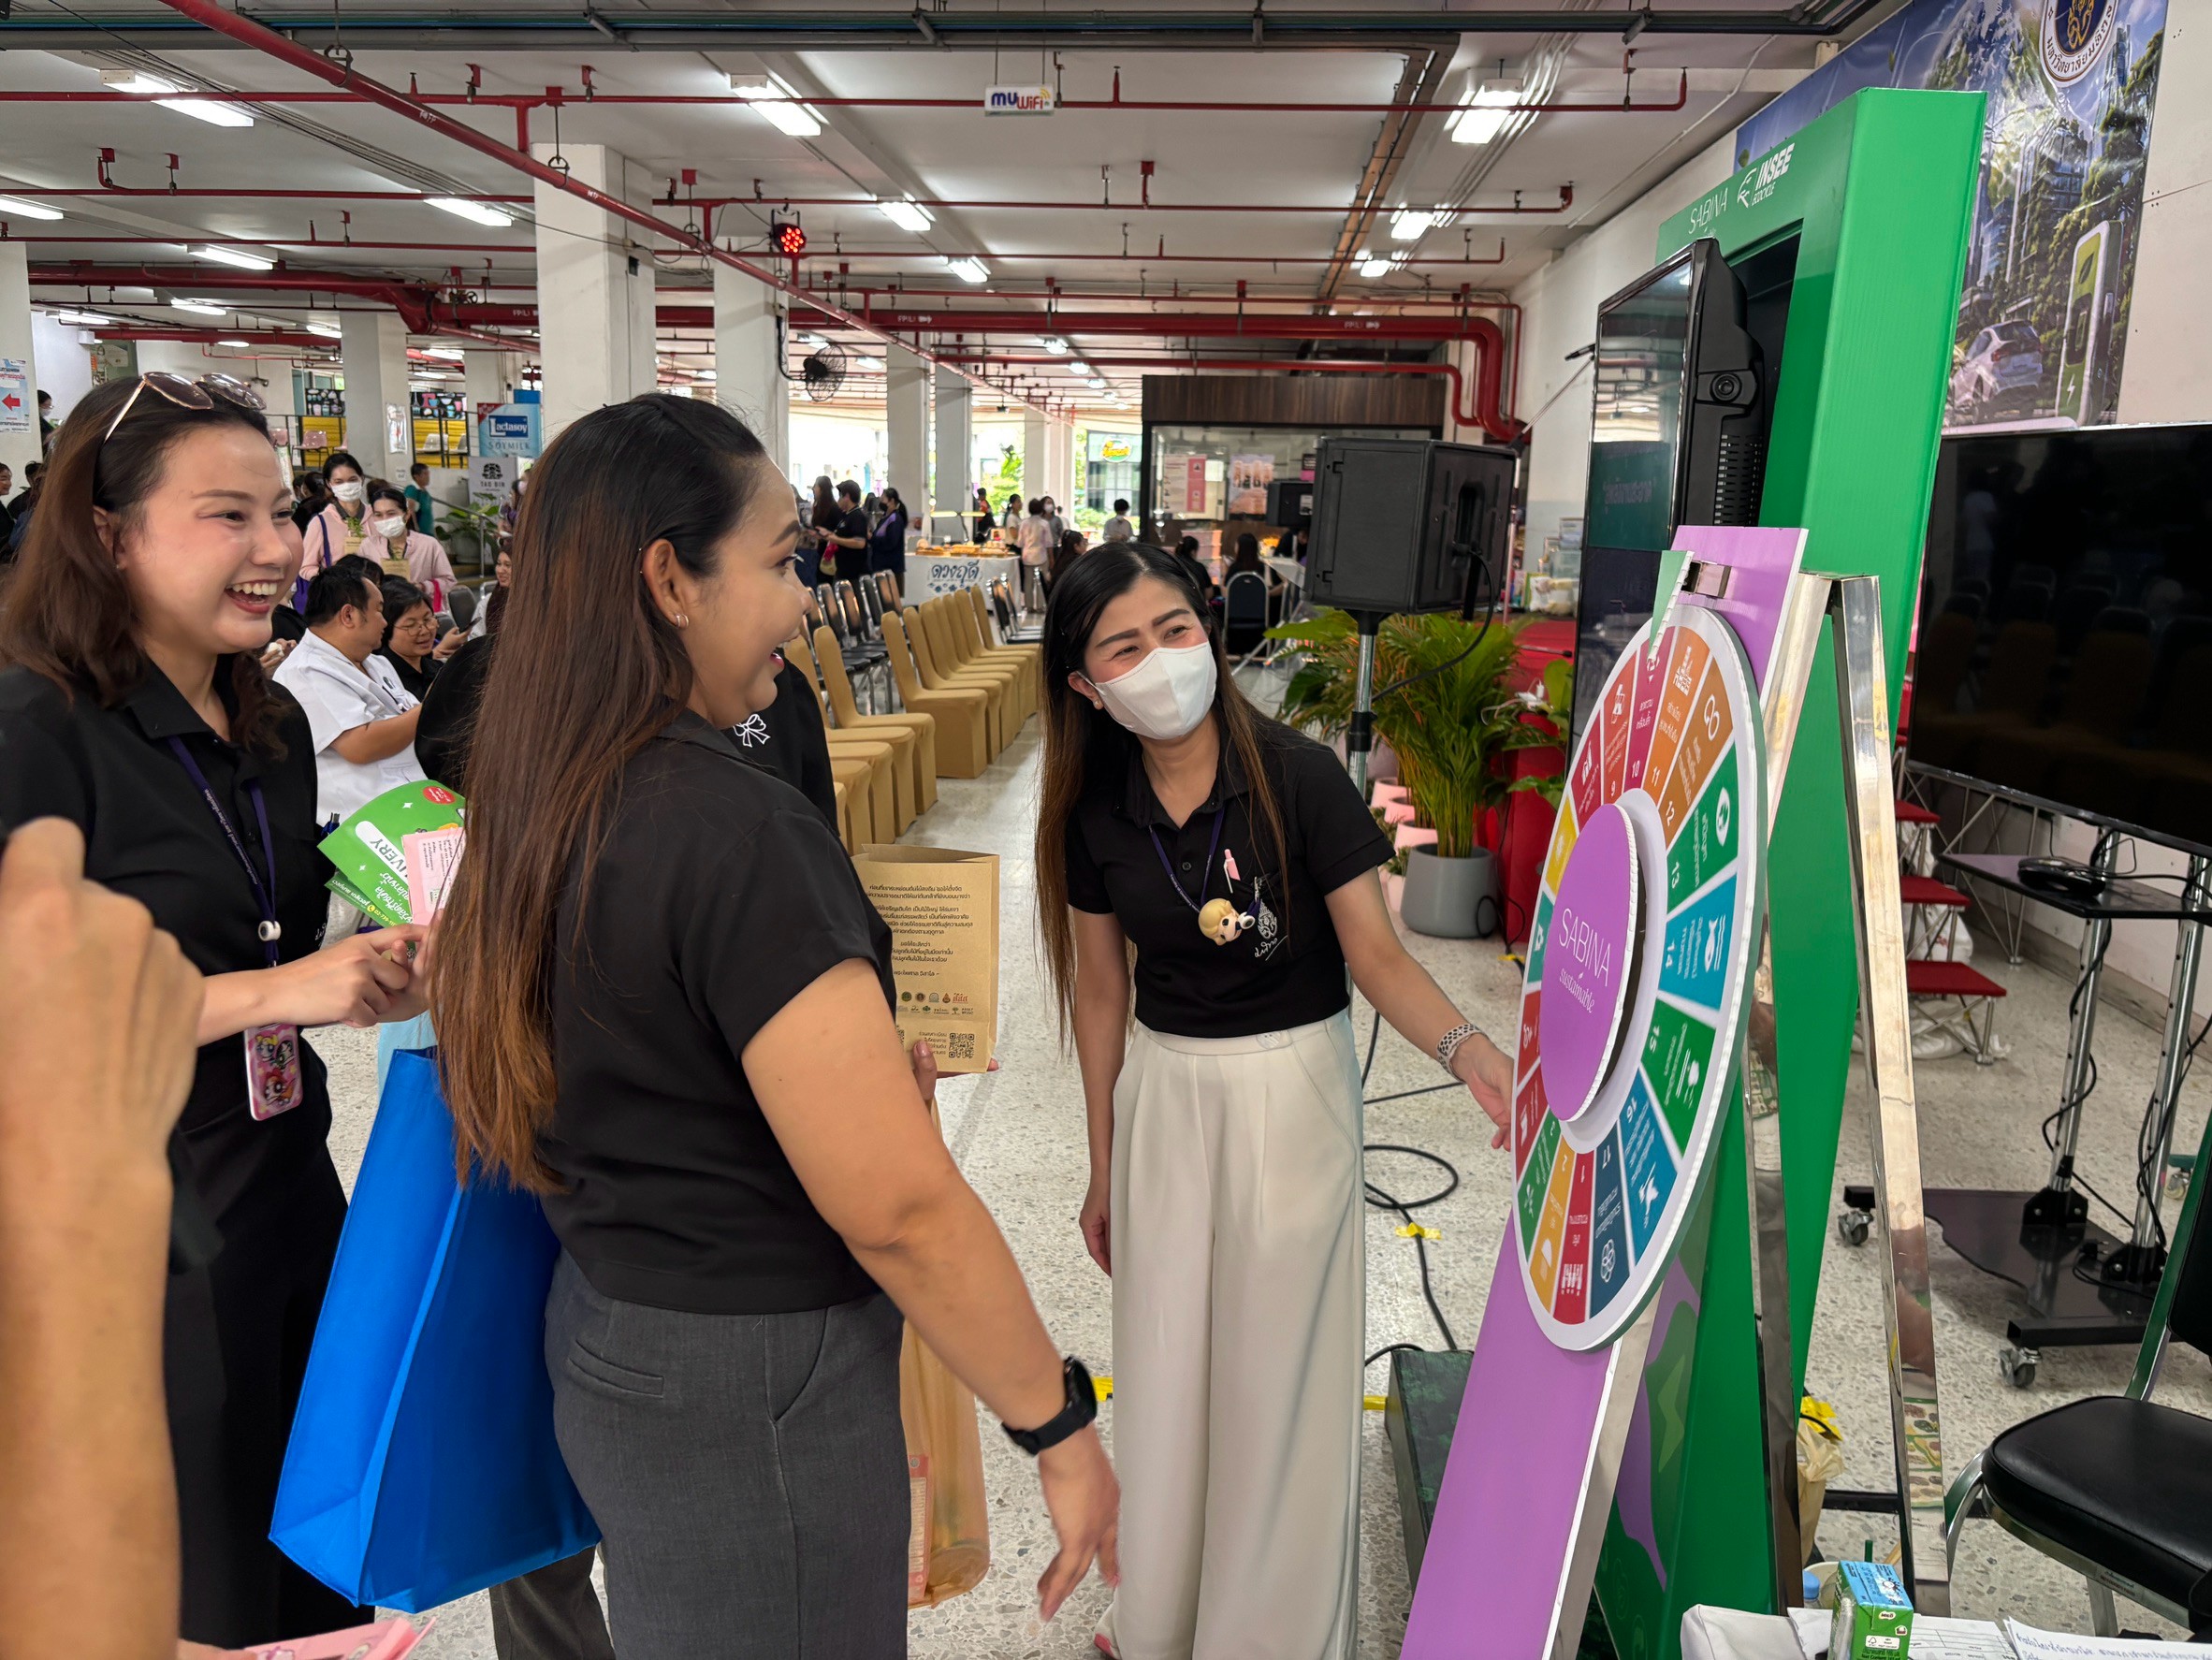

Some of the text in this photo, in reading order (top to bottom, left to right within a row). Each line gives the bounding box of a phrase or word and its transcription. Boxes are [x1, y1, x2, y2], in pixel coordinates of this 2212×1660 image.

[1755, 142, 1796, 192] INSEE
[1688, 187, 1729, 235] SABINA
[489, 417, 528, 436] Lactasoy
[488, 441, 530, 450] SOYMILK
[1632, 760, 1640, 779] 10
[1652, 765, 1660, 788] 11
[1610, 780, 1617, 797] 9
[1666, 800, 1675, 826] 12
[371, 838, 408, 878] IVERY
[1671, 861, 1680, 889] 13
[1559, 908, 1611, 987] SABINA
[1666, 939, 1675, 969] 14
[1559, 968, 1595, 1013] sustainable
[1650, 1026, 1660, 1053] 15
[1626, 1097, 1637, 1124] 16
[1562, 1154, 1568, 1172] 2
[1602, 1144, 1611, 1169] 17
